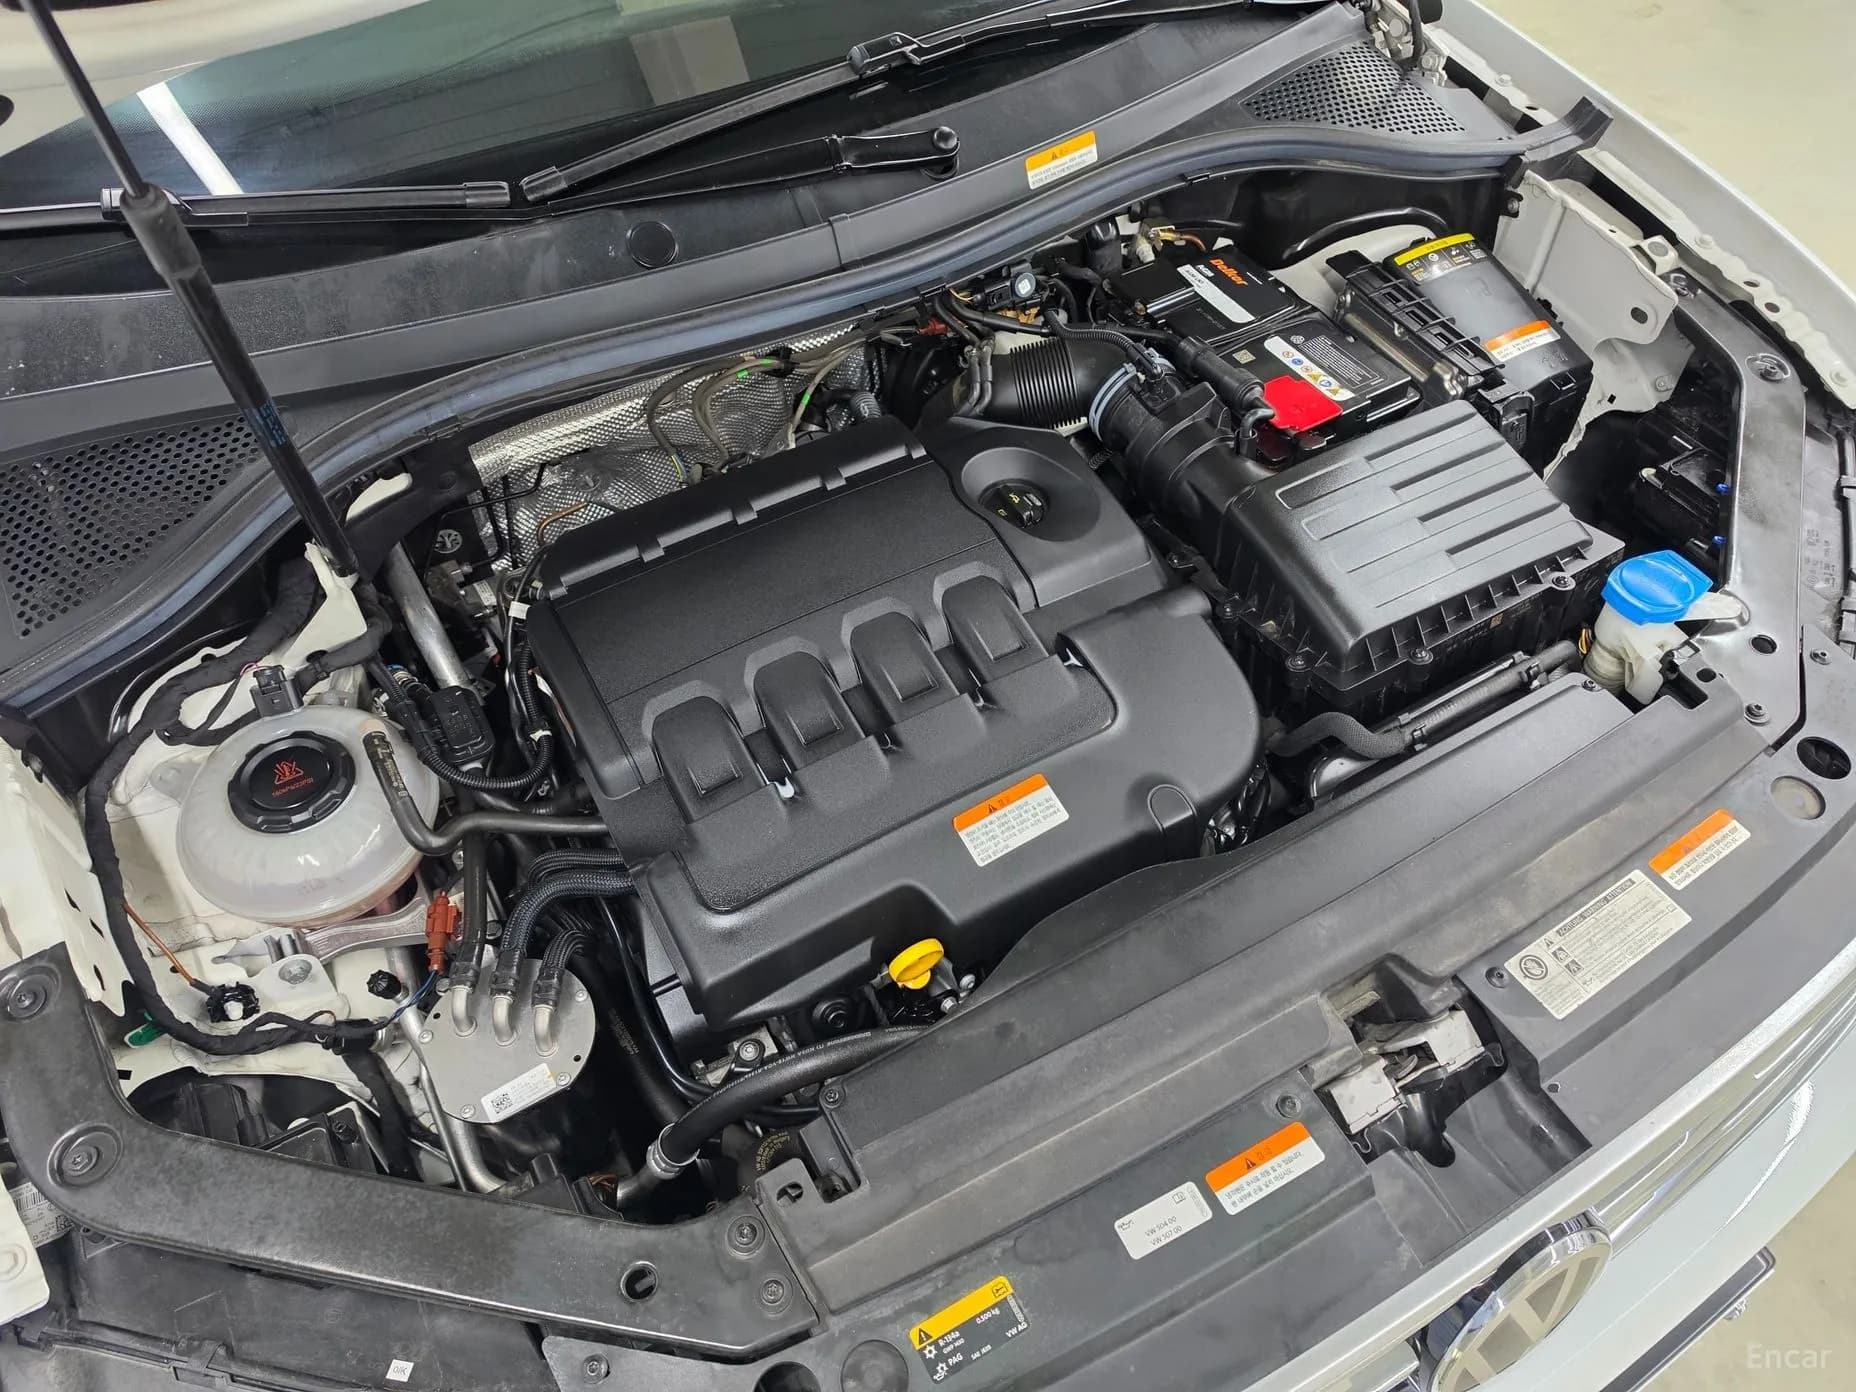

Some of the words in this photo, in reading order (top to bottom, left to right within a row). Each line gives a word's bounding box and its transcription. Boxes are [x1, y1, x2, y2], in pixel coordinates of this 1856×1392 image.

[1209, 258, 1248, 287] Delkor
[1144, 1227, 1157, 1237] VW
[1151, 1236, 1162, 1246] VW
[1162, 1229, 1173, 1239] 507
[1005, 1327, 1017, 1338] VW
[1017, 1321, 1028, 1332] AG
[947, 1352, 963, 1366] PAG
